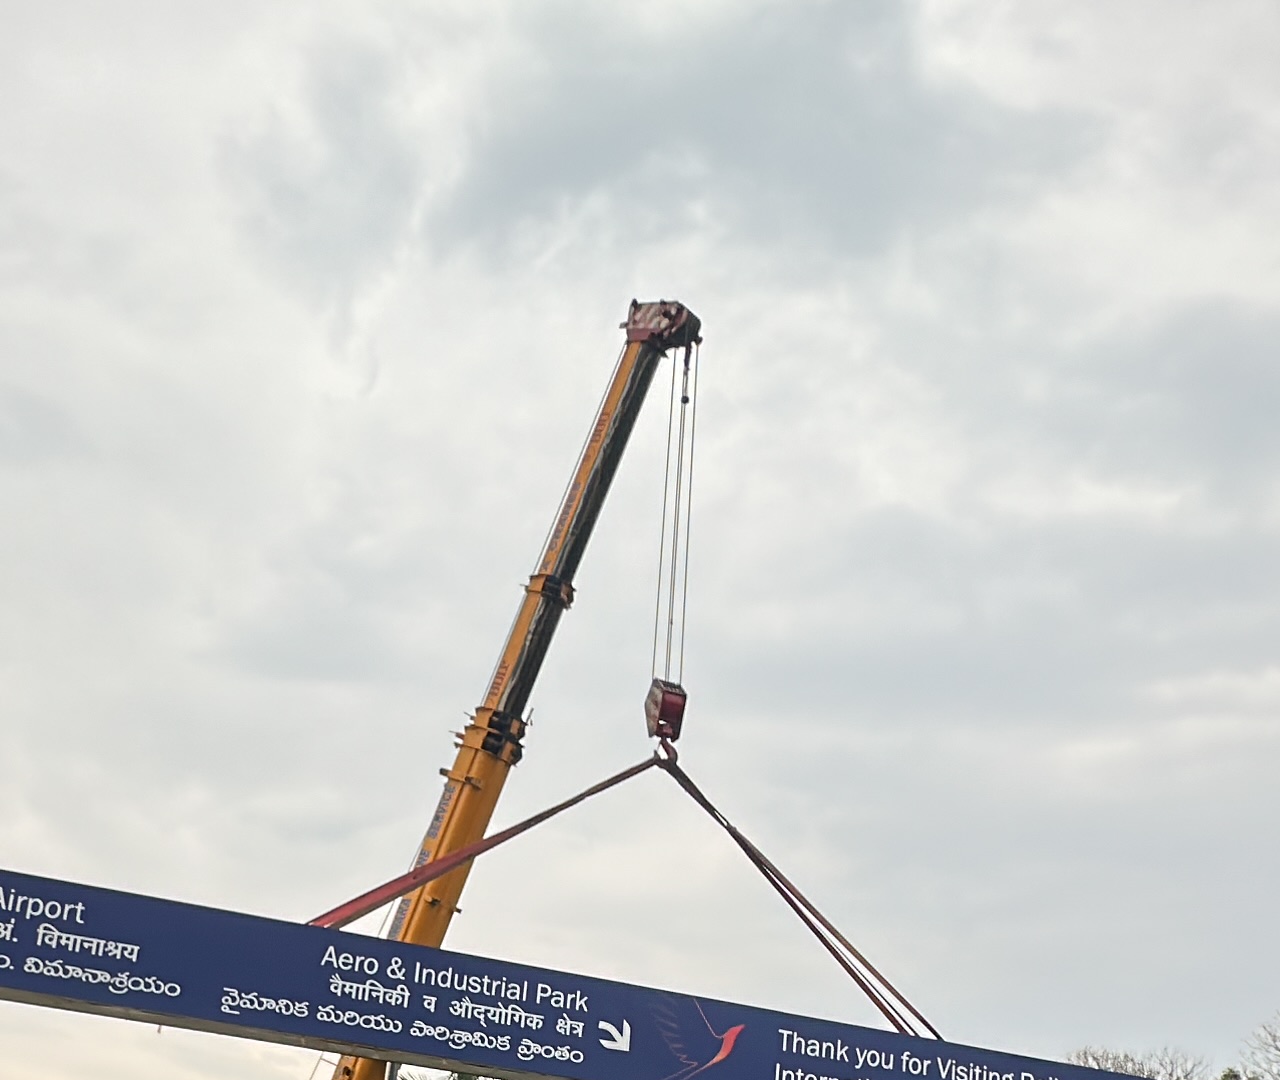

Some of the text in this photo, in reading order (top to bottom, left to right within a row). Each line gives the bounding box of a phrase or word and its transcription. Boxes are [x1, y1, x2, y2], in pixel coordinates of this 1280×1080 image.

[36, 923, 140, 962] विमानाश्रय
[23, 956, 181, 997] విమానాశ్రయం
[320, 945, 589, 1012] Aero & Industrial Park
[220, 986, 584, 1063] వైమానిక మరియు పారిశ్రామిక ప్రాంతం
[329, 973, 411, 1008] वैमानिकी
[422, 994, 437, 1012] व
[555, 1013, 585, 1037] क्षेत्र
[778, 1028, 849, 1062] Thank
[854, 1048, 894, 1070] you
[901, 1051, 931, 1076] for
